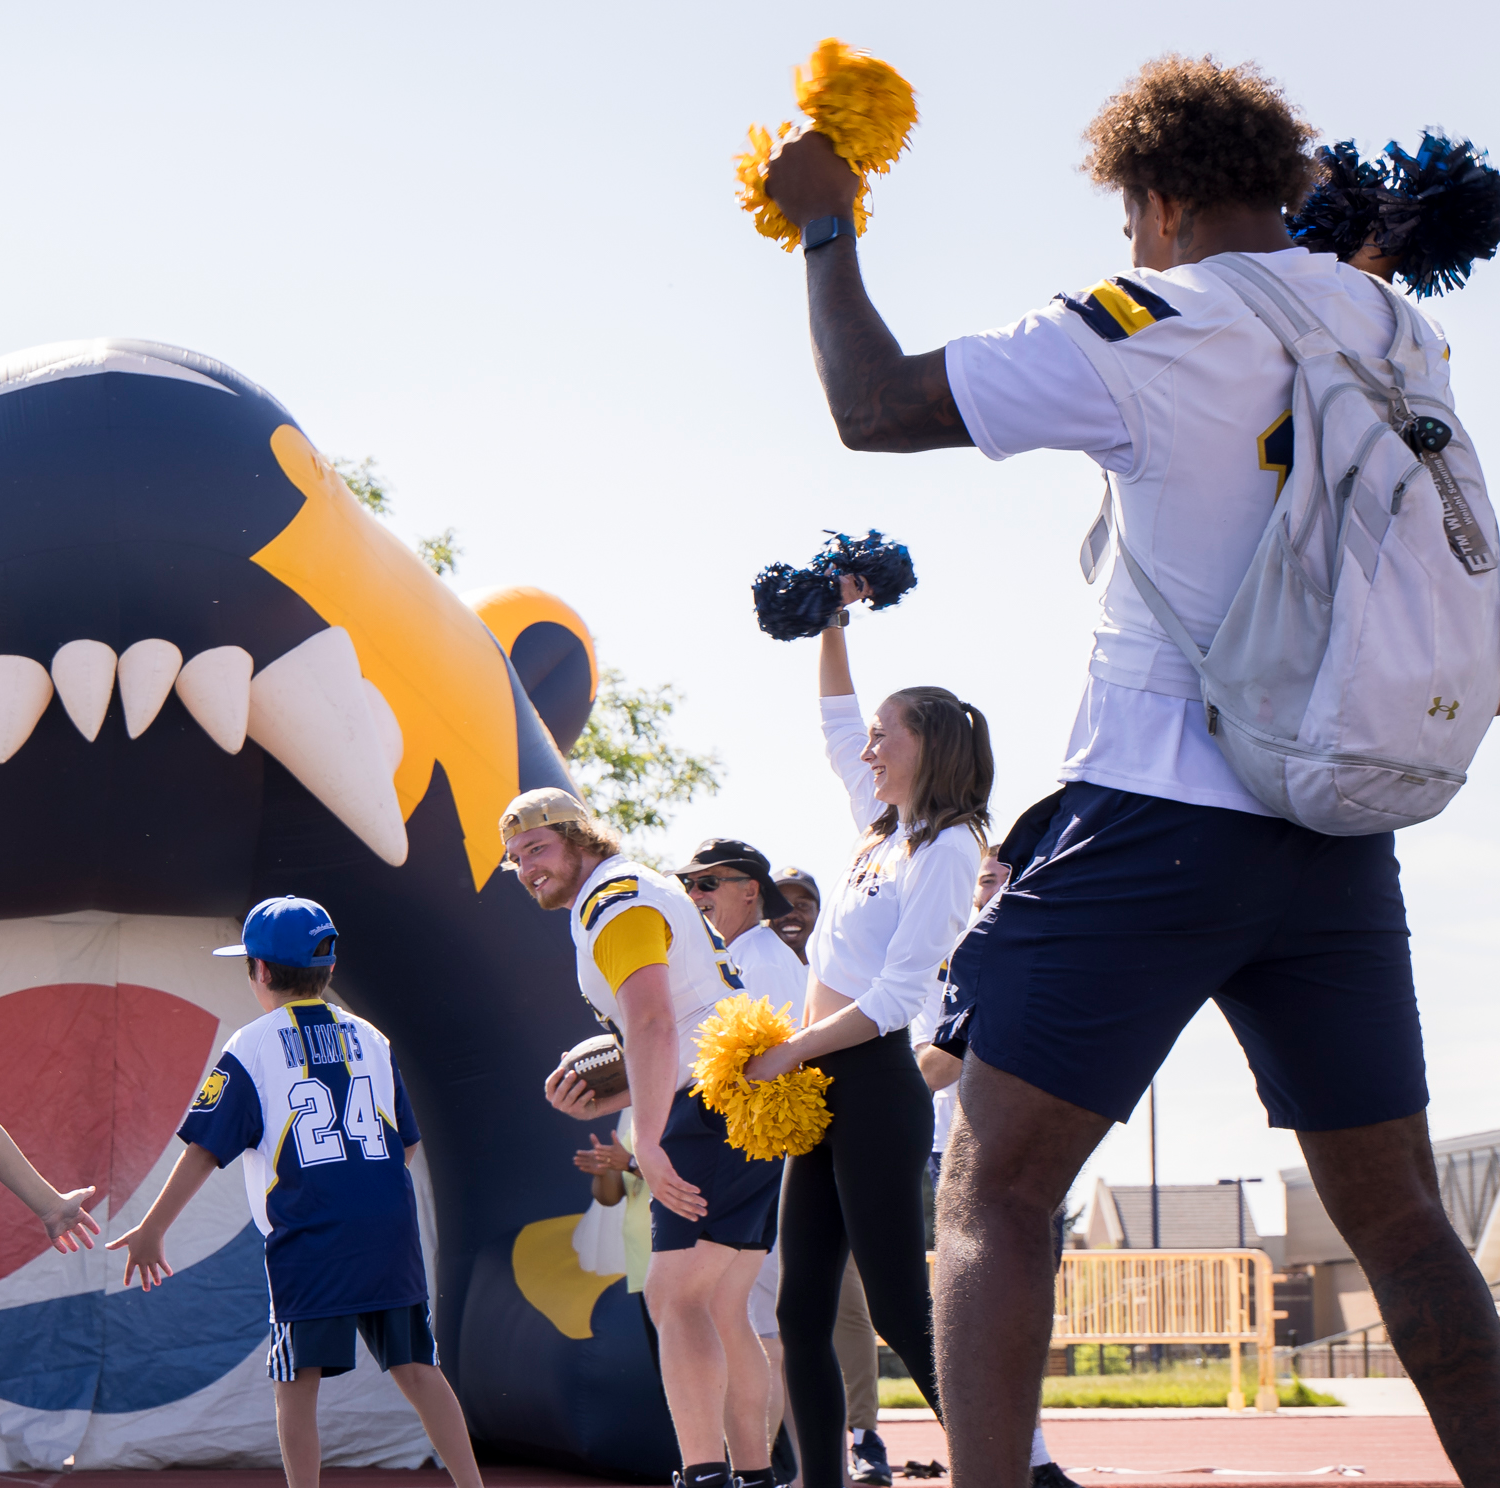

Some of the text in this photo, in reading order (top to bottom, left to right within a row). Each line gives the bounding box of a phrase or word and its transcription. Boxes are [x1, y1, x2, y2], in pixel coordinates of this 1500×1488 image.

[1434, 459, 1457, 494] Securing
[1453, 495, 1473, 526] Weight
[277, 1021, 364, 1069] NO LIMITS
[287, 1075, 391, 1168] 24
